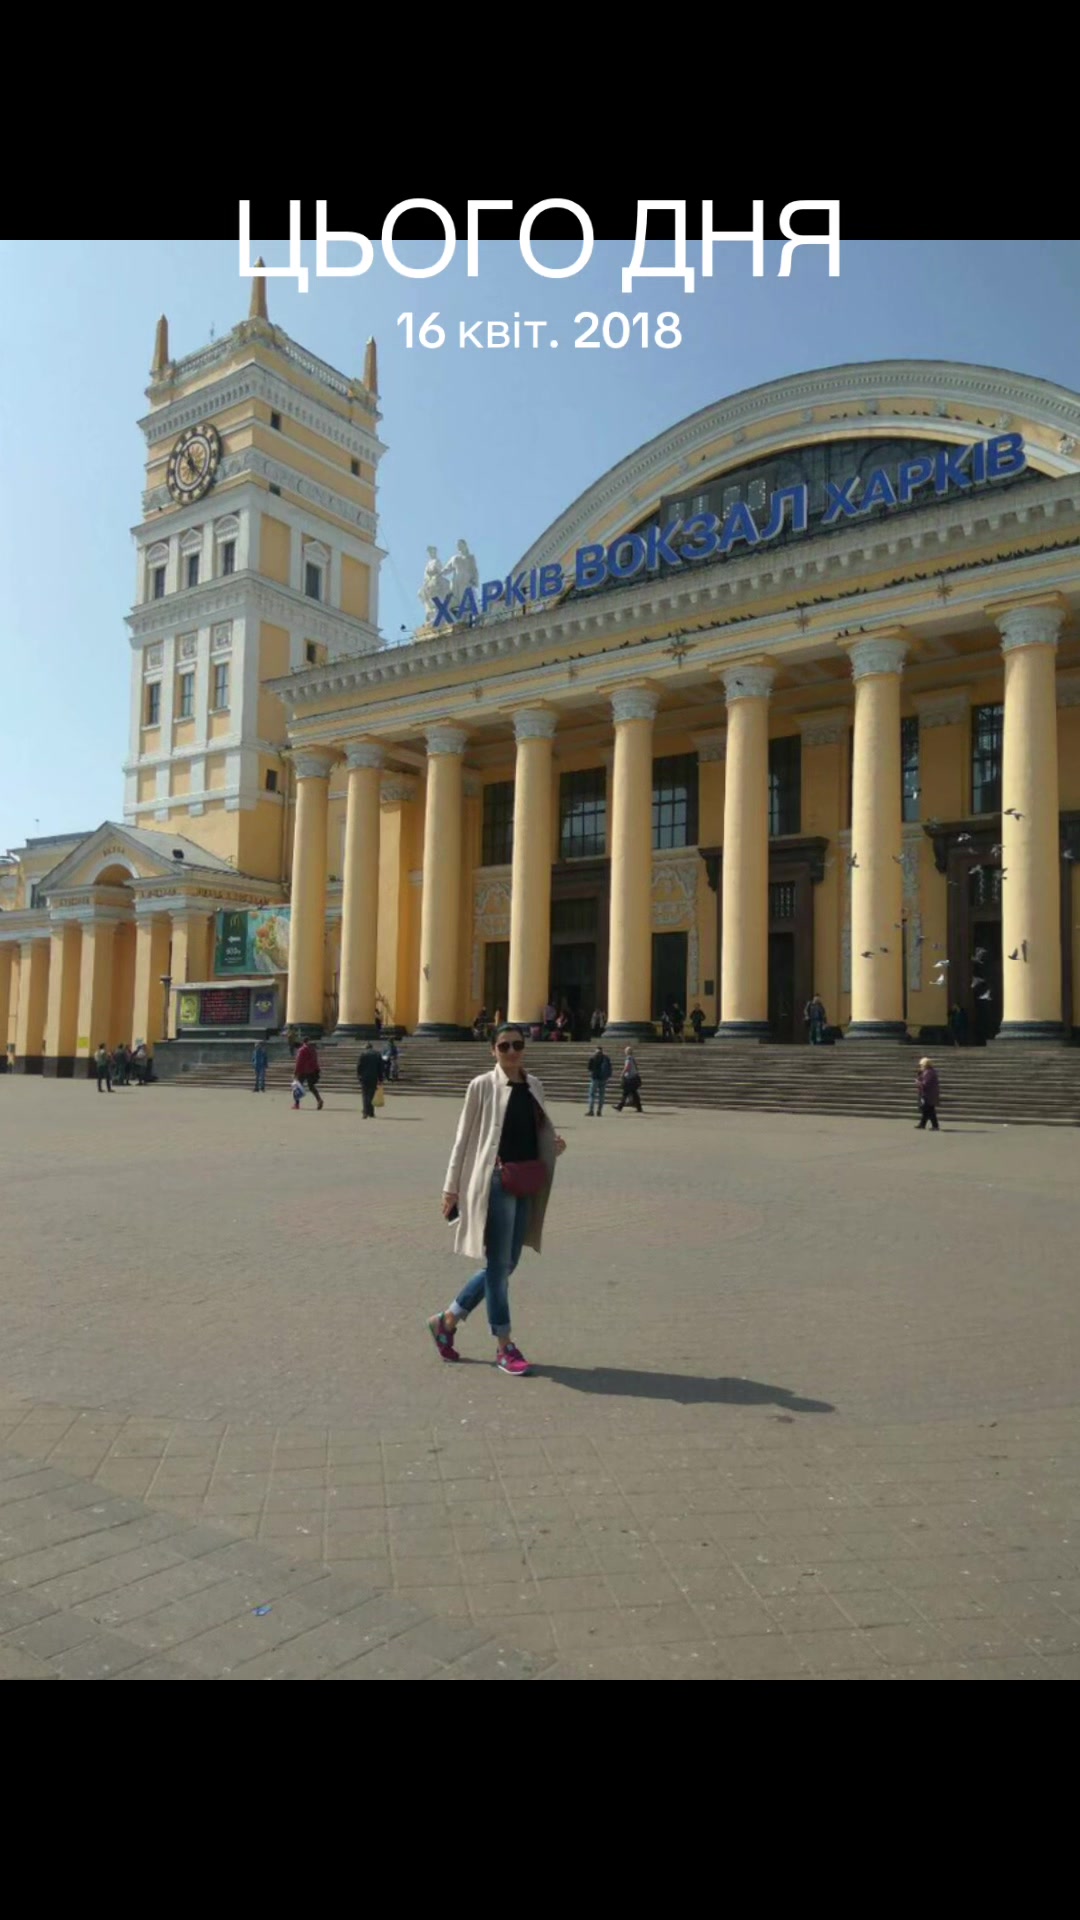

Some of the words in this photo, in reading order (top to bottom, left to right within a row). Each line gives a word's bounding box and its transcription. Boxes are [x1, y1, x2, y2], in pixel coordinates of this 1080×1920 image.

[431, 563, 562, 627] ХАРКІВ
[575, 484, 807, 590] ВОКЗАЛ
[821, 432, 1027, 525] ХАРКІВ
